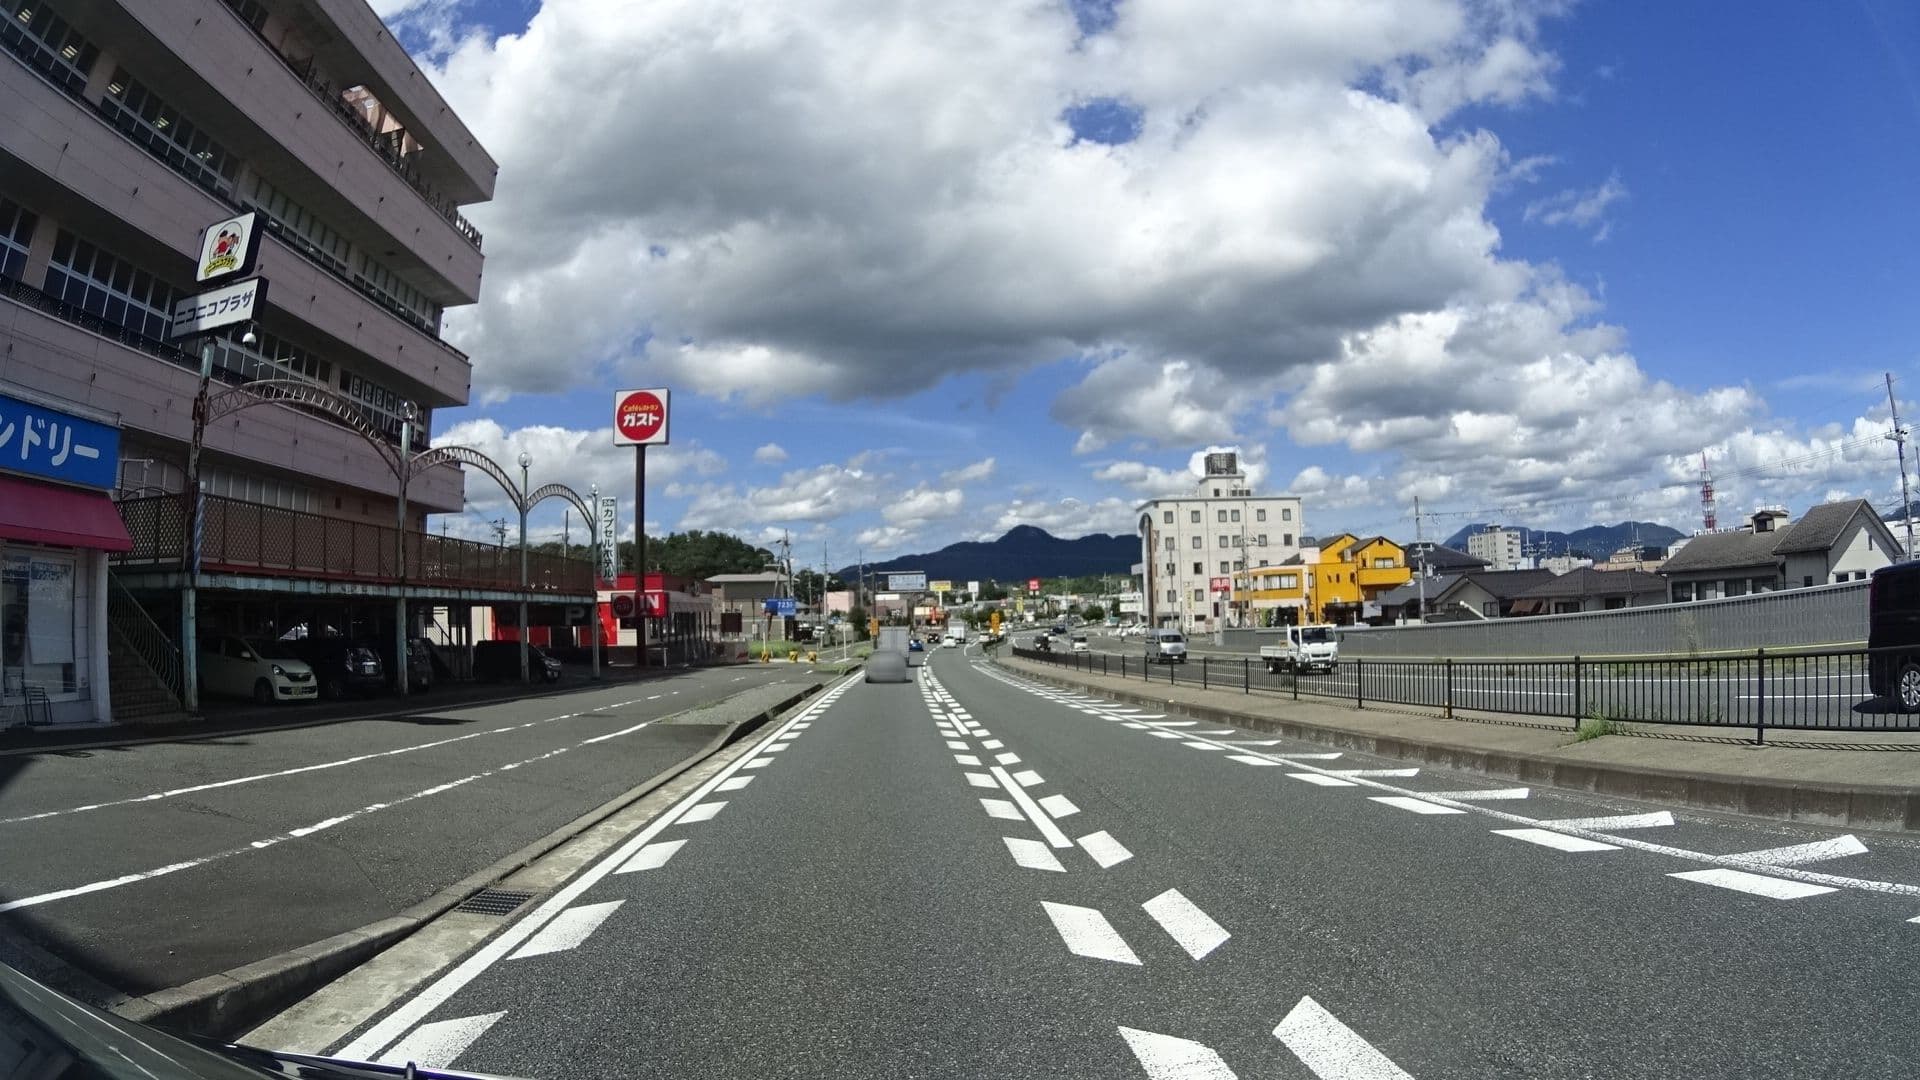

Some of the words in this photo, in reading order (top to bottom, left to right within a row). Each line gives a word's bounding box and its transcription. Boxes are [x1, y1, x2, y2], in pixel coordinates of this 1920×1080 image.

[175, 288, 254, 325] ニコニコプラザ
[623, 413, 660, 427] ガスト
[603, 509, 614, 578] カプセルホテル
[639, 594, 660, 609] IN
